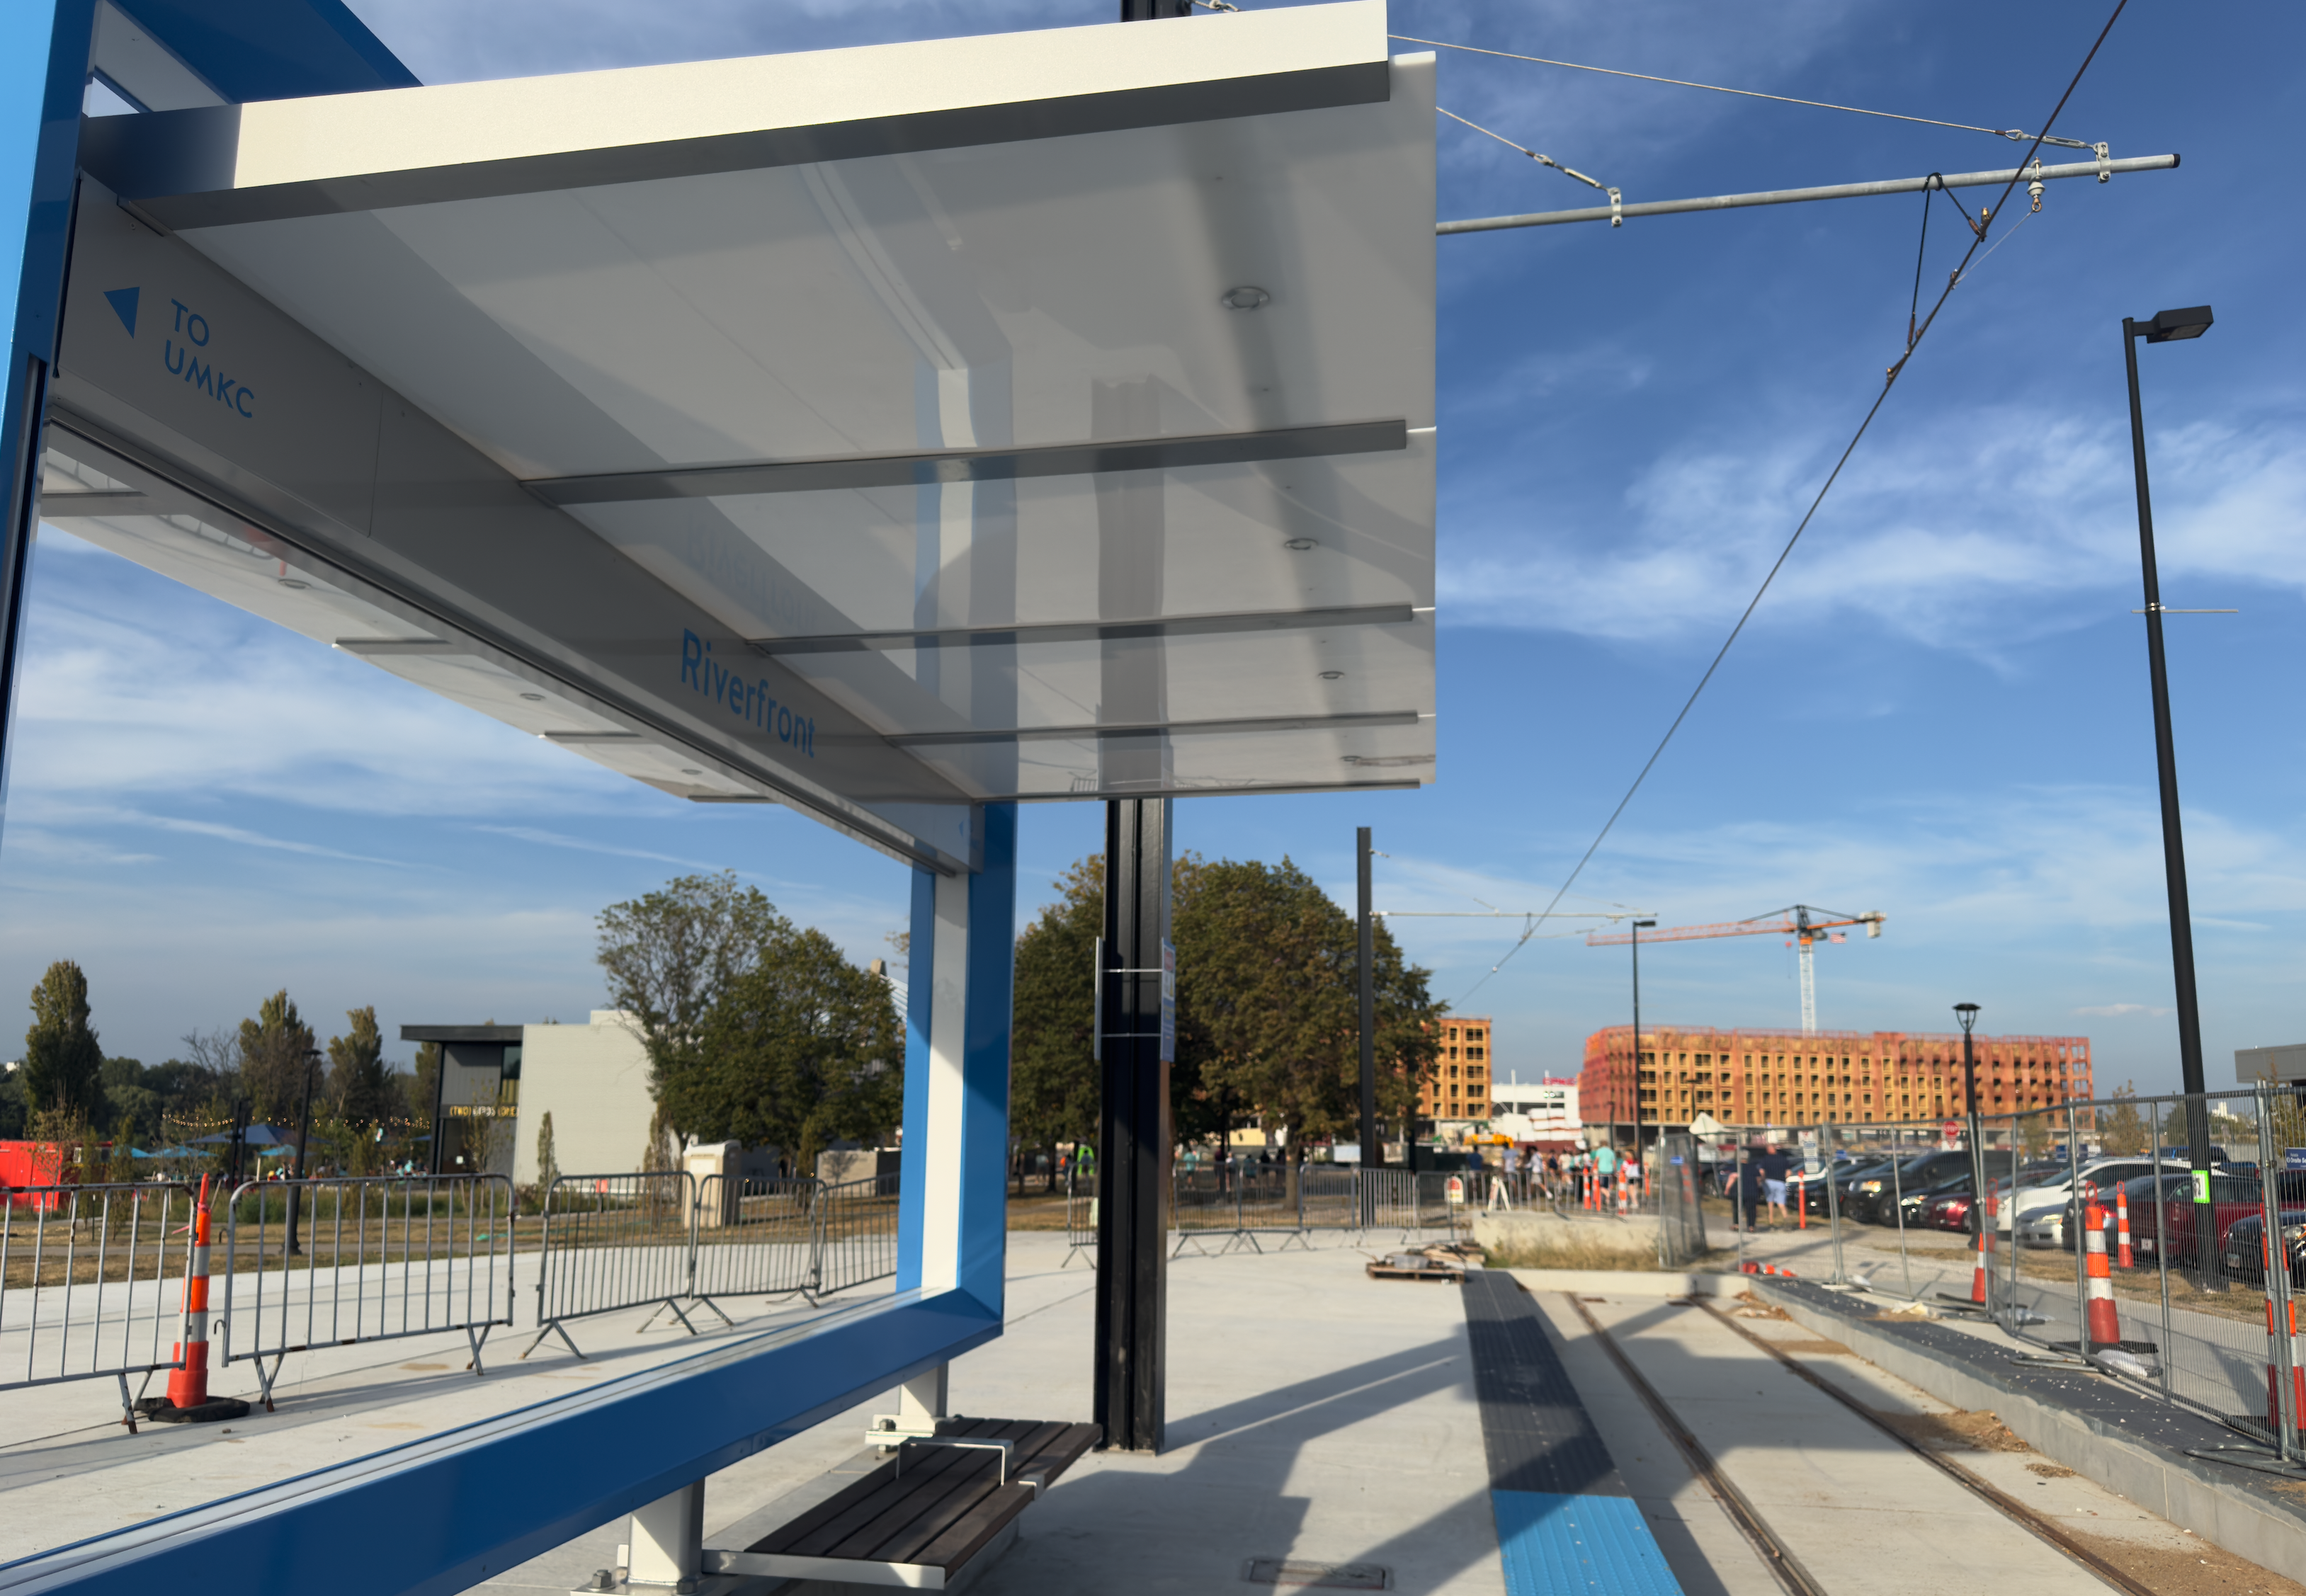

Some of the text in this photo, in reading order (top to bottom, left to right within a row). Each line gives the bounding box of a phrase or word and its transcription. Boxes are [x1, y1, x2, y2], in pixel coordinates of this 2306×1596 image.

[171, 297, 210, 347] TO
[164, 339, 255, 418] UMKC
[681, 627, 815, 758] Riverfront
